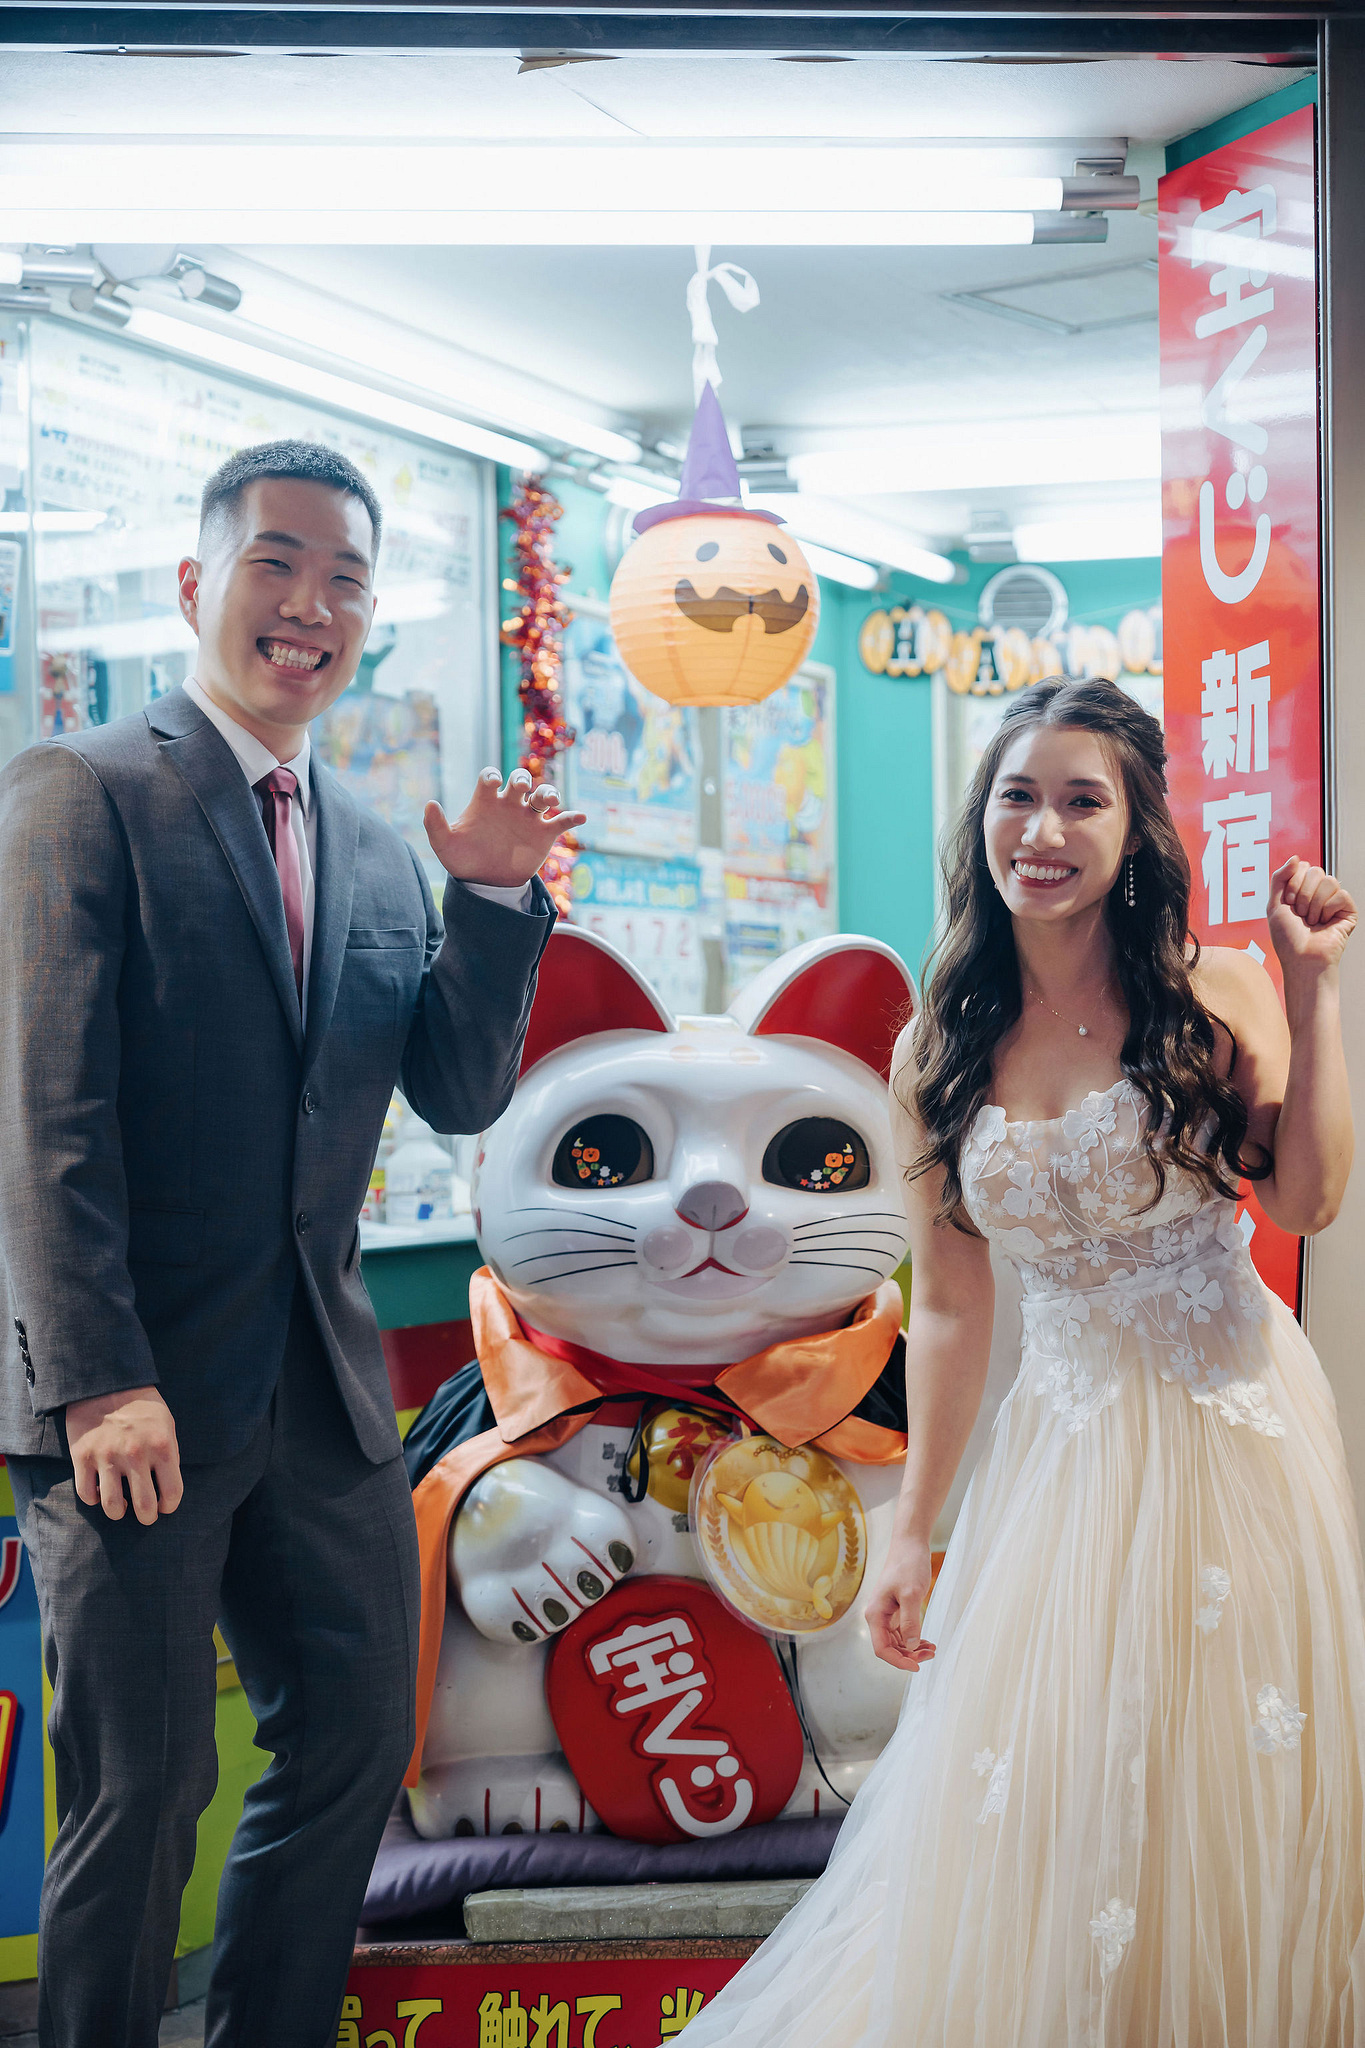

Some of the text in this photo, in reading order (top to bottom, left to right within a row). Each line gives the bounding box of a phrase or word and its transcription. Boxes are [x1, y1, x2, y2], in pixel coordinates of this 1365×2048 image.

[1191, 184, 1277, 926] 宝くじ 新宿
[589, 1617, 753, 1838] 宝くじ
[478, 1990, 622, 2048] 触れて
